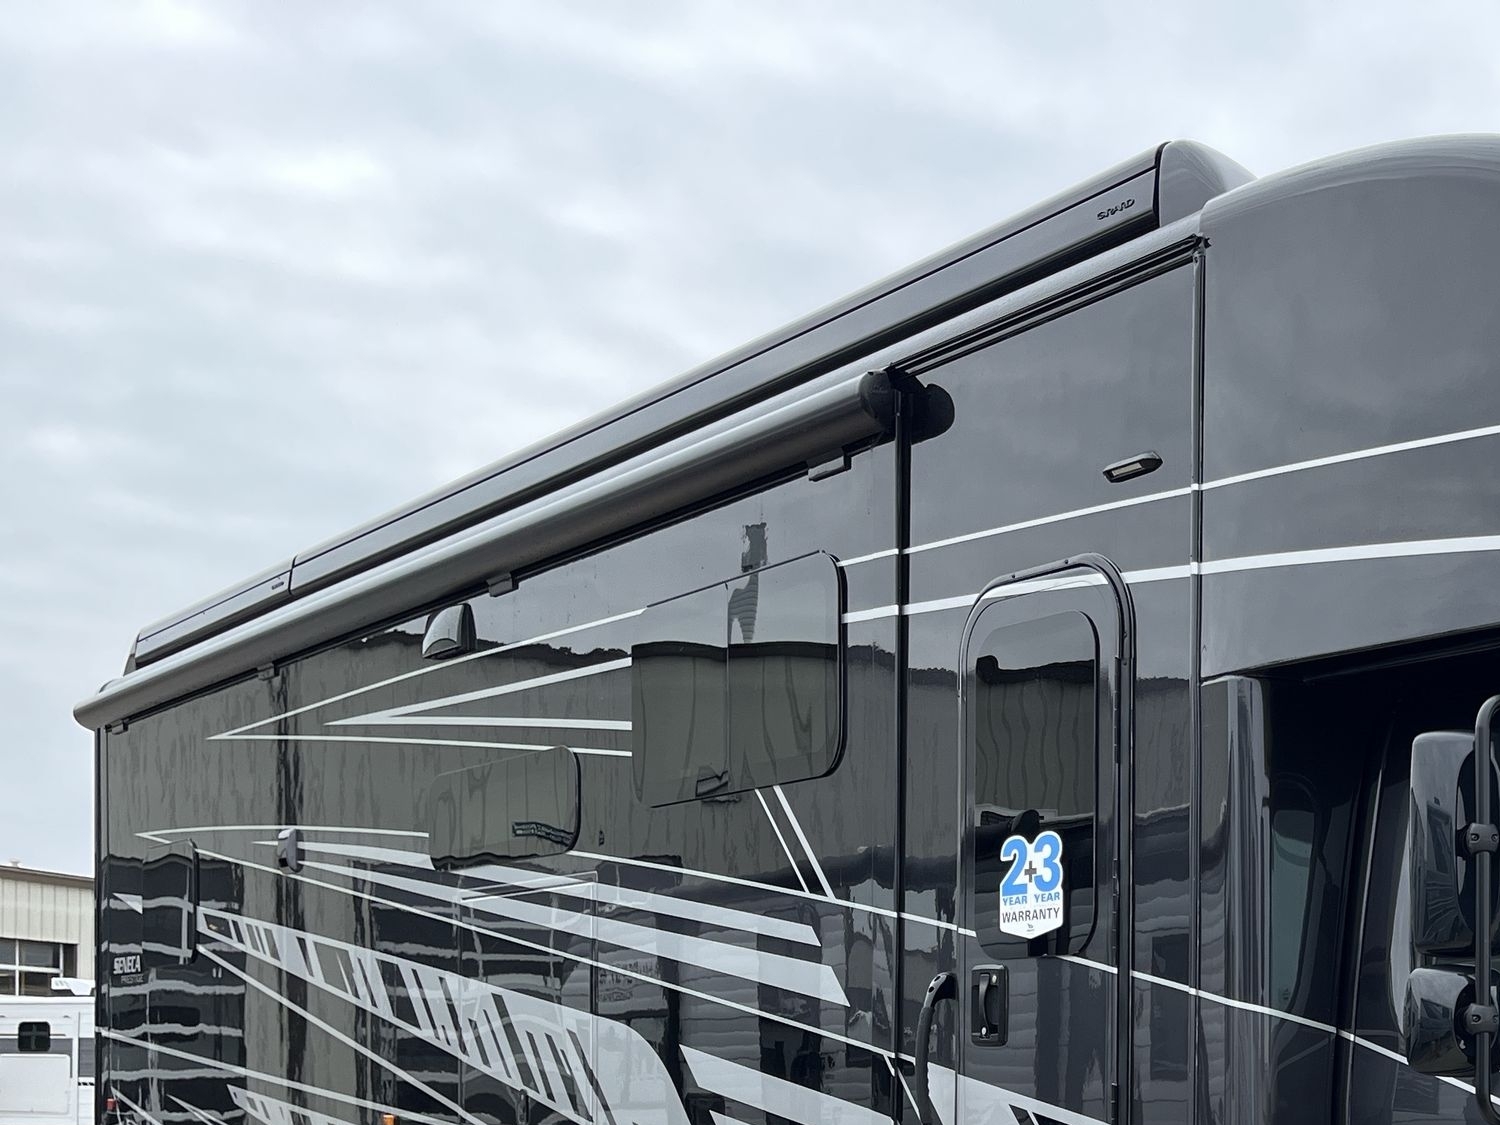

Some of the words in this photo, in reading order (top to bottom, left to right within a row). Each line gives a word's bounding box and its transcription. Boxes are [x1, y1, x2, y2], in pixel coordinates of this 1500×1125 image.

[1003, 896, 1028, 906] YEAR
[1034, 892, 1061, 903] YEAR
[1002, 907, 1060, 924] WARRANTY
